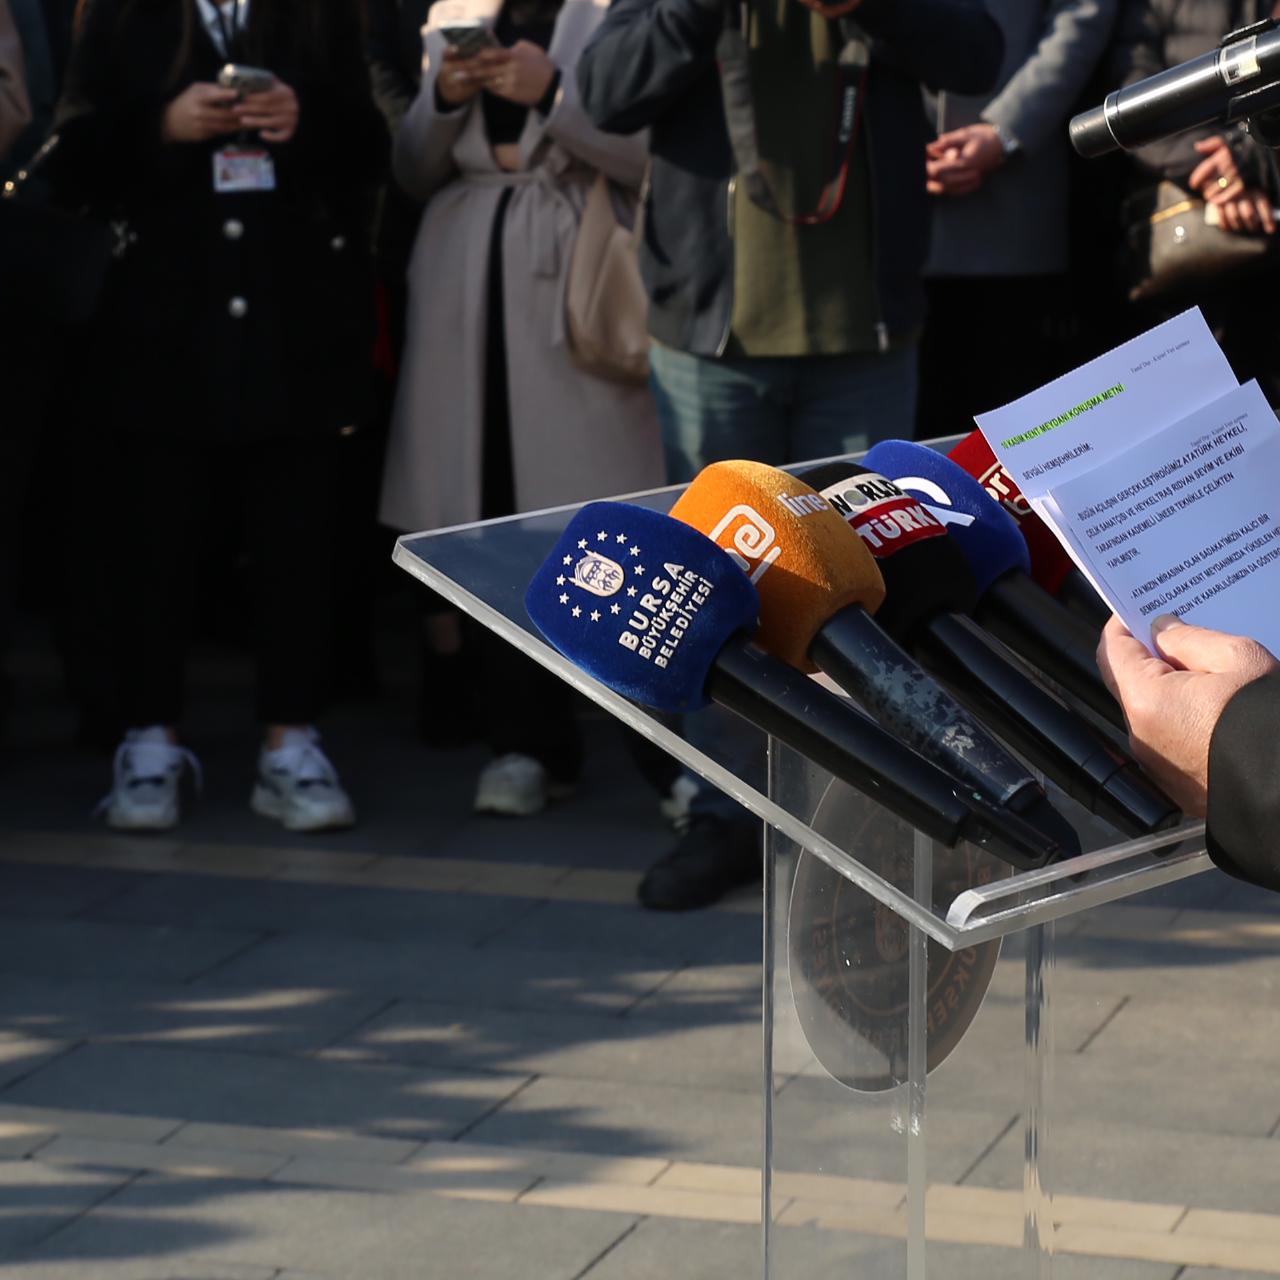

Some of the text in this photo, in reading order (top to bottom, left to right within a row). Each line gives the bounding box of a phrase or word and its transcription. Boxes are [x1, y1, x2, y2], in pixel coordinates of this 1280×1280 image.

[1005, 433, 1024, 448] KASIM
[1021, 425, 1042, 441] KENT
[1038, 411, 1070, 433] MEYDANI
[1066, 393, 1104, 419] KONUŞMA
[1100, 381, 1124, 401] METNİ
[1095, 470, 1236, 555] TARAFINDAN KADEMELİ LİNEER TEKNİKLE ÇELİKTEN
[1098, 509, 1130, 534] SANATÇISI
[1126, 506, 1136, 517] VE
[1133, 485, 1174, 514] HEYKELTRAŞ
[1170, 472, 1196, 492] RIDVAN
[1192, 460, 1215, 479] SEVİM
[1213, 455, 1225, 467] VE
[1222, 442, 1245, 461] EKİBİ
[1114, 457, 1184, 502] GERÇEKLEŞTİRDİĞİMİZ
[1180, 439, 1214, 464] ATATÜRK
[855, 505, 939, 548] TÜRK
[1155, 561, 1186, 584] MİRASINA
[1183, 553, 1201, 569] OLAN
[1197, 528, 1243, 560] SADAKATİMİZİN
[1239, 518, 1260, 535] KALICI
[1256, 511, 1270, 525] BİR
[618, 562, 684, 652] BURSA
[638, 570, 700, 660] BÜYÜKŞEHİR
[1138, 592, 1168, 616] SEMBOLÜ
[1164, 581, 1190, 601] OLARAK
[1187, 571, 1206, 587] KENT
[1202, 547, 1246, 578] MEYDANIMIZDA
[1241, 530, 1274, 555] YÜKSELEN
[1193, 595, 1203, 606] VE
[1247, 561, 1258, 572] DA
[654, 577, 715, 669] BELEDİYESİ
